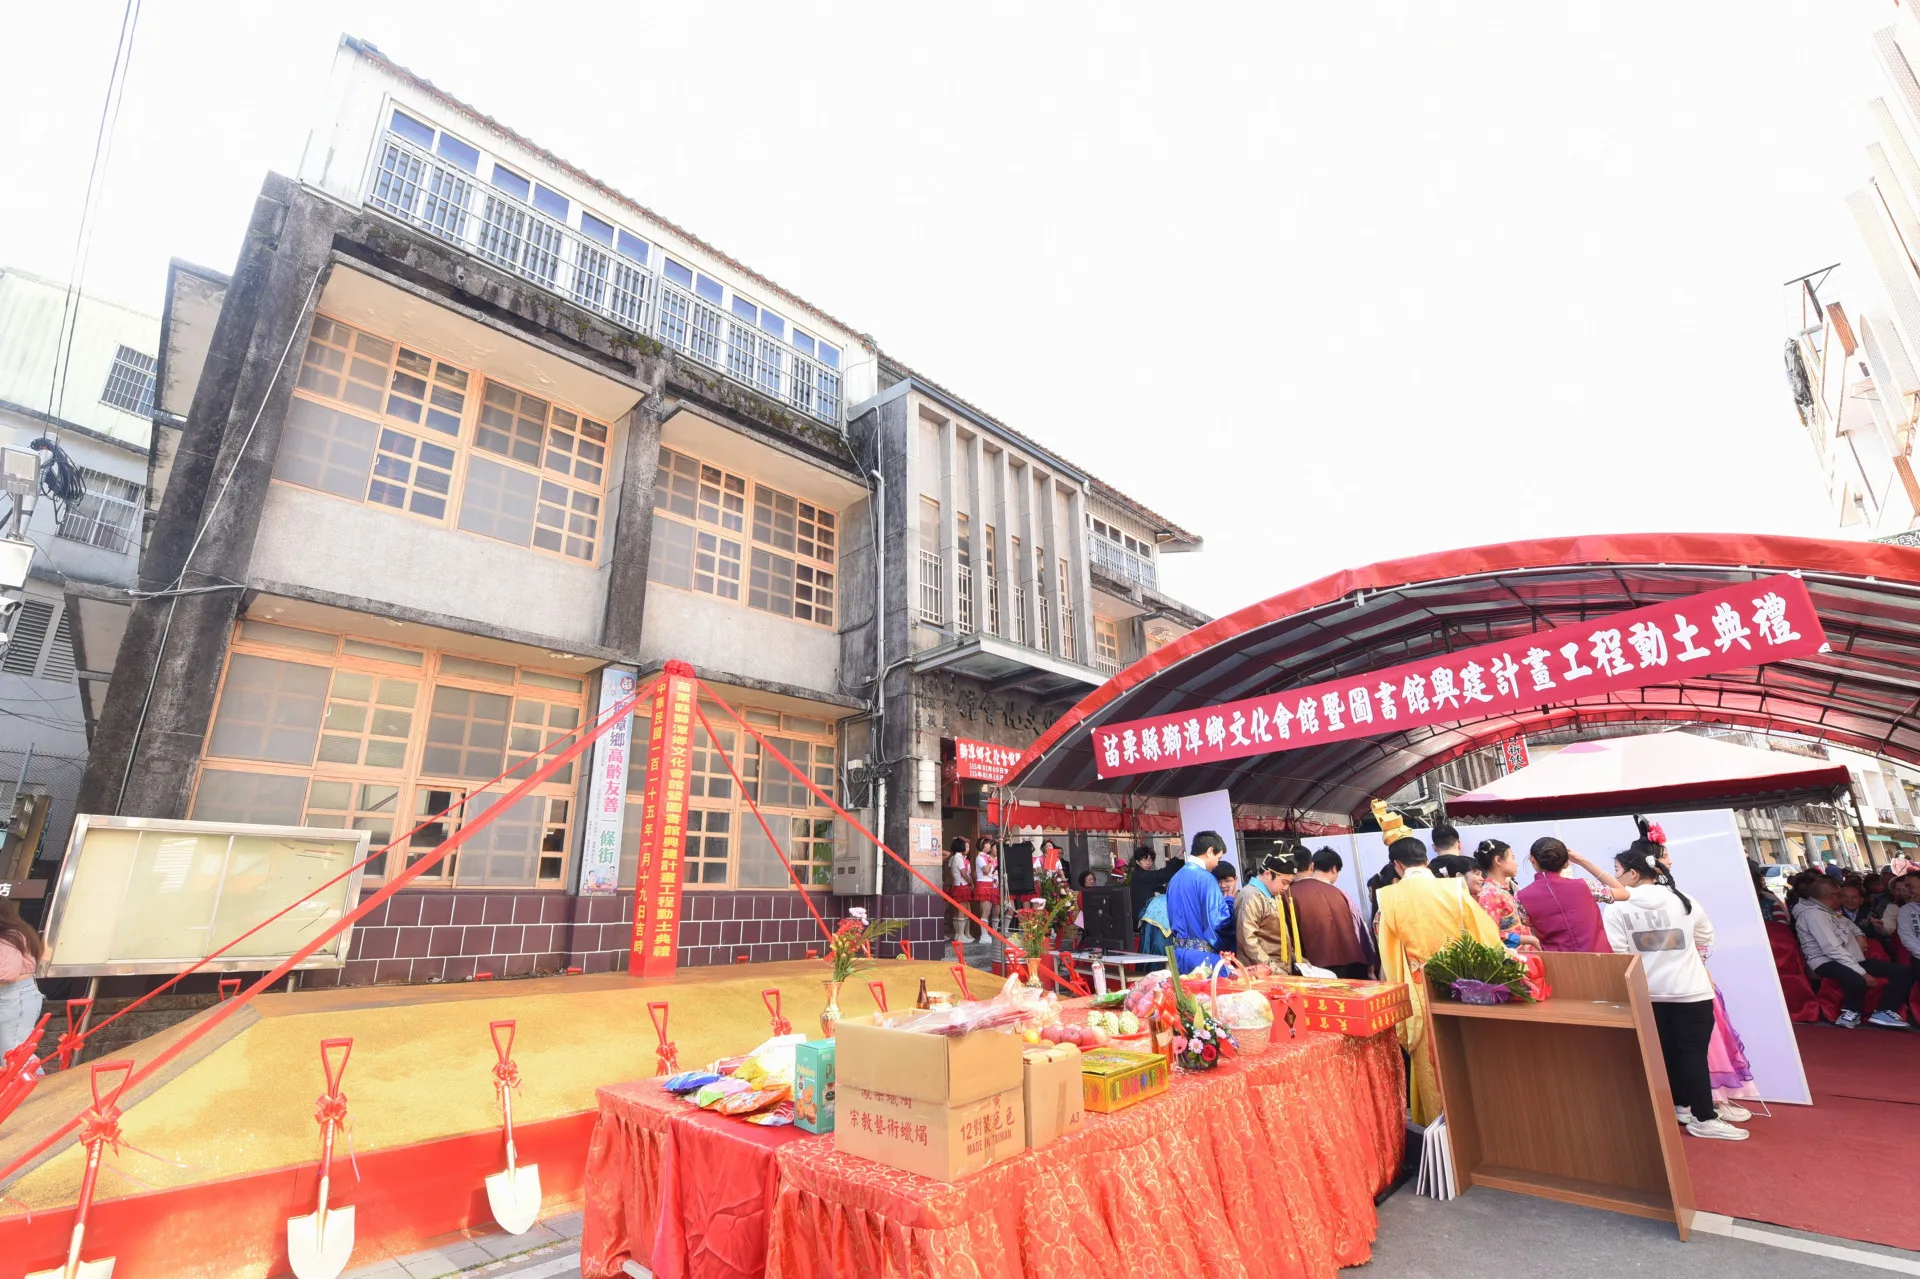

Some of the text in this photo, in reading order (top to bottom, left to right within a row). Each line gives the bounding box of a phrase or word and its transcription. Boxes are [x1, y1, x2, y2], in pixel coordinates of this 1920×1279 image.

[1103, 592, 1801, 767] 苗栗縣獅潭鄉文化會館暨圖書館興建計畫工程動土典禮
[633, 683, 666, 954] 中華民國一百一十五年一月十九日吉時
[653, 681, 692, 957] 苗栗縣獅潭鄉文化會館暨圖書館興建計畫工程動土典禮
[1623, 910, 1671, 930] I'M
[849, 1109, 928, 1147] 宗教藝術蠟燭
[967, 1139, 983, 1156] MADE
[992, 1128, 1012, 1145] TAIWAN
